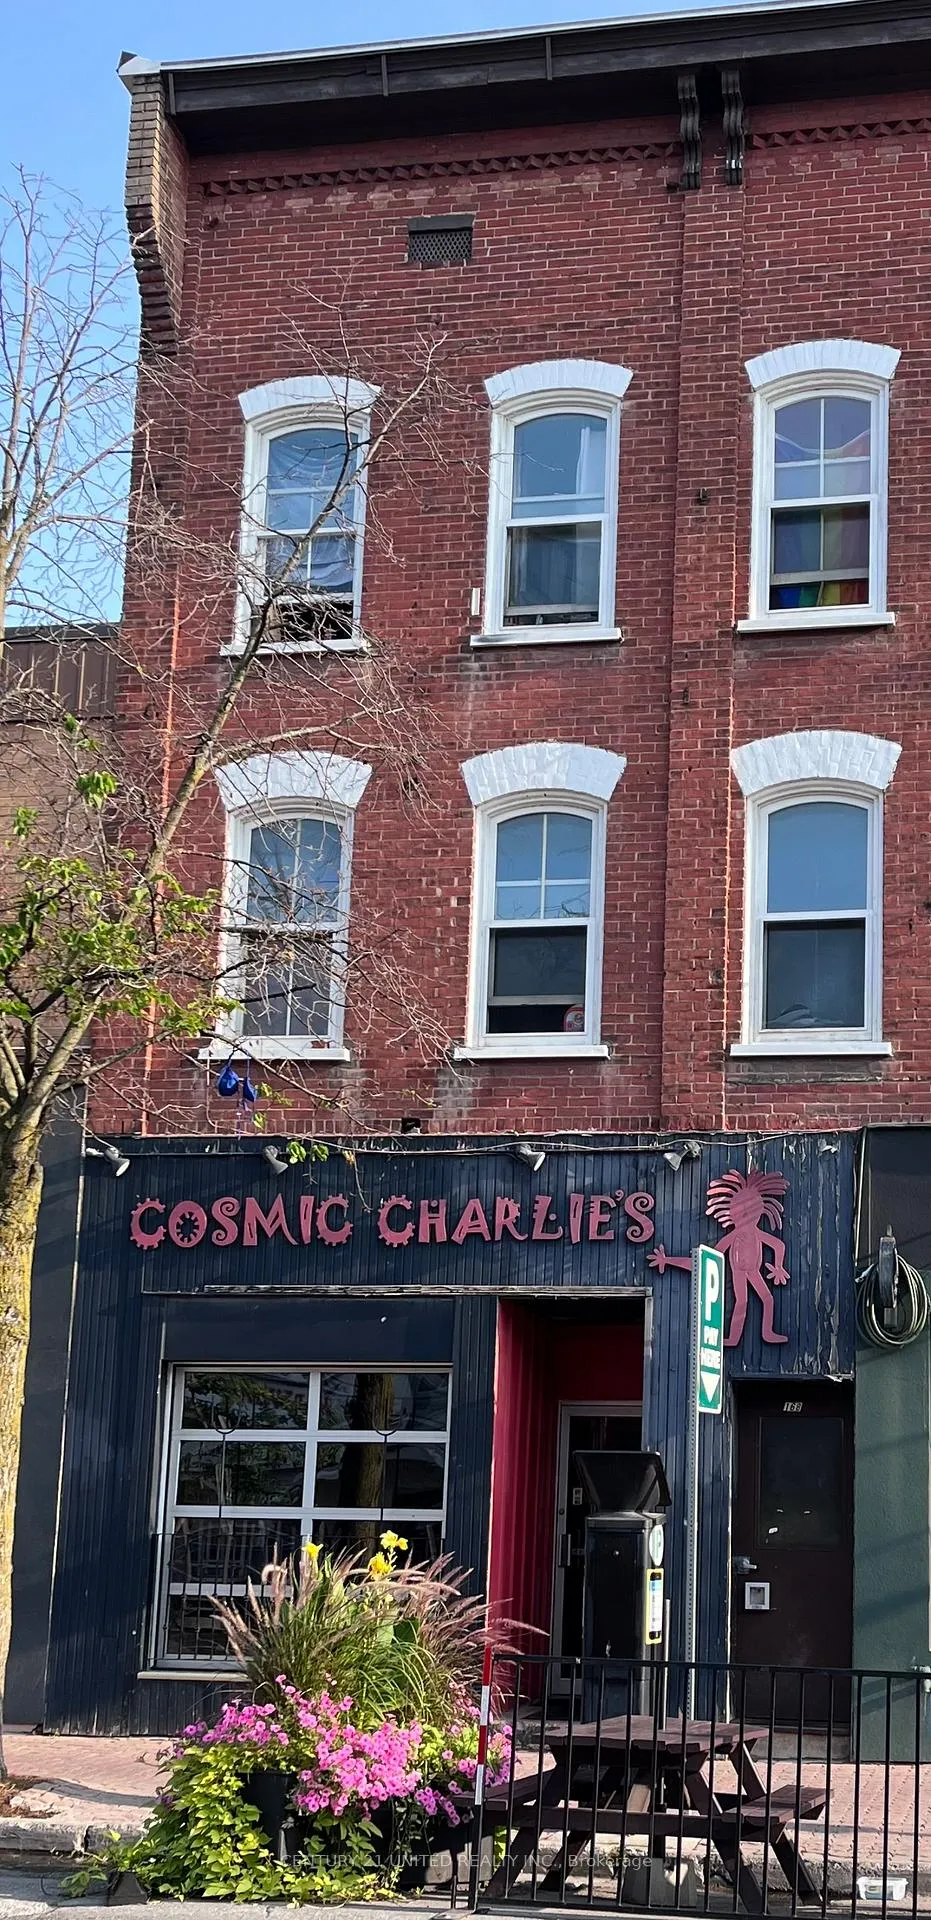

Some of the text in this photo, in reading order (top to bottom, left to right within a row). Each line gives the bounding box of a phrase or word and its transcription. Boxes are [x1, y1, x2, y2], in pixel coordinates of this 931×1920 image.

[130, 1189, 655, 1250] COSMIC CHARLIE'S
[704, 1257, 720, 1322] P
[703, 1325, 719, 1346] PAY
[700, 1346, 721, 1369] HERE
